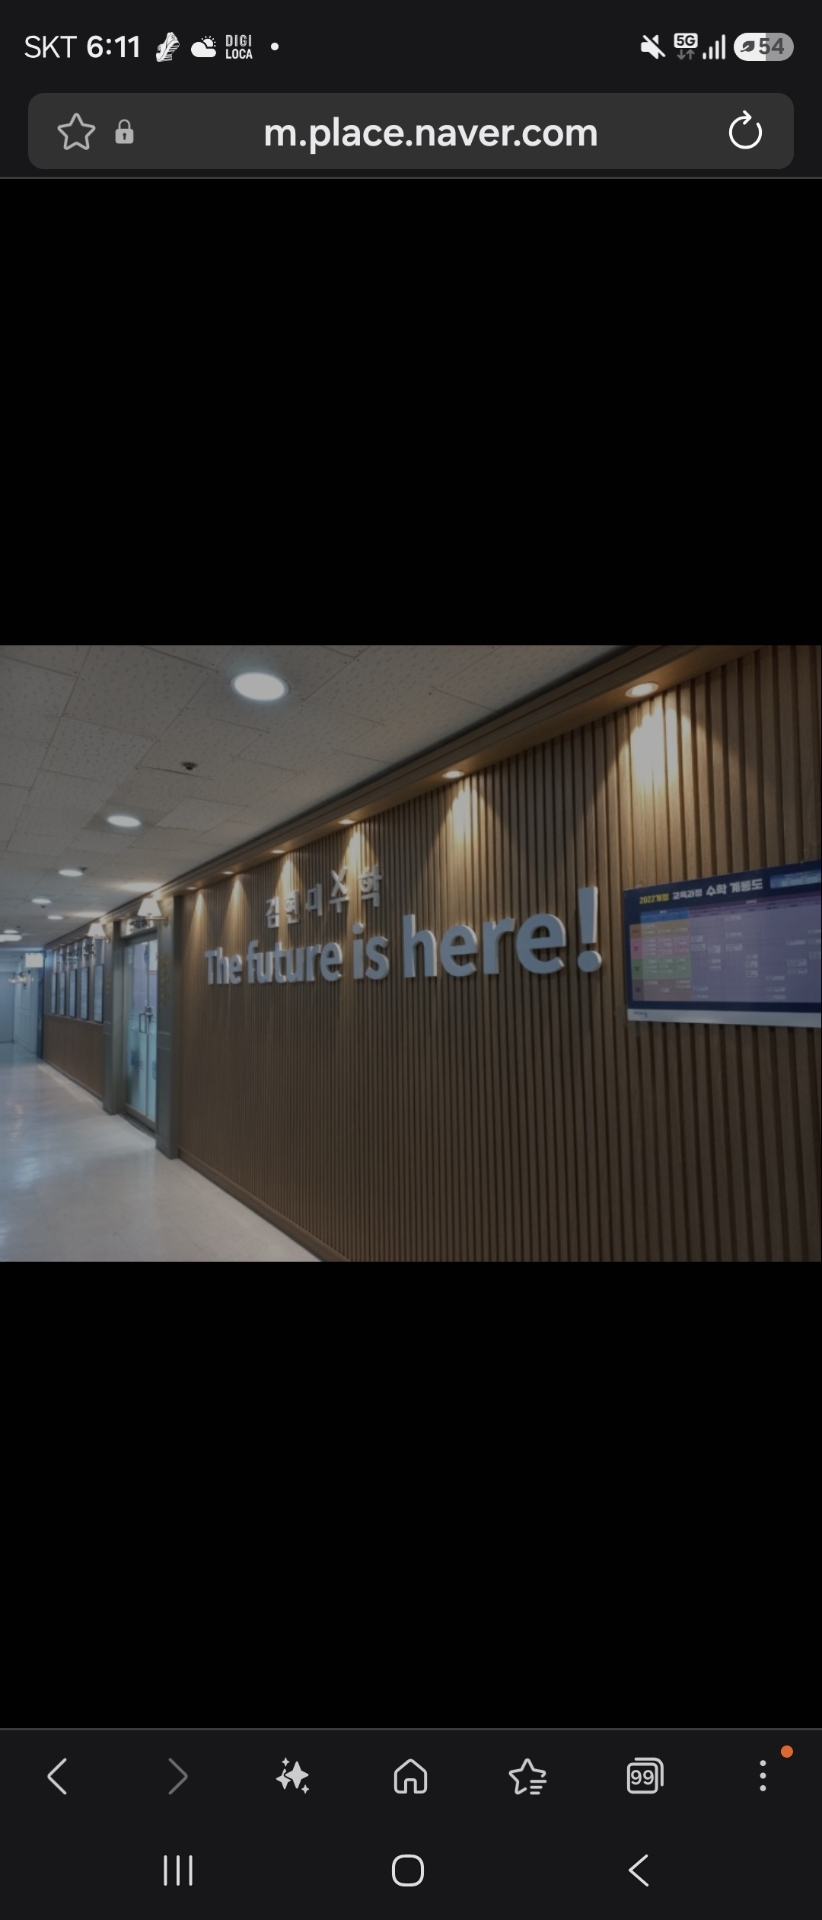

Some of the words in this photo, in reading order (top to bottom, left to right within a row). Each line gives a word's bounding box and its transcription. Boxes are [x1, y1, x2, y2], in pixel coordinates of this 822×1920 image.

[706, 883, 728, 896] 수학
[205, 947, 243, 985] The
[247, 939, 343, 984] future
[353, 922, 390, 980] is
[403, 886, 603, 978] here!
